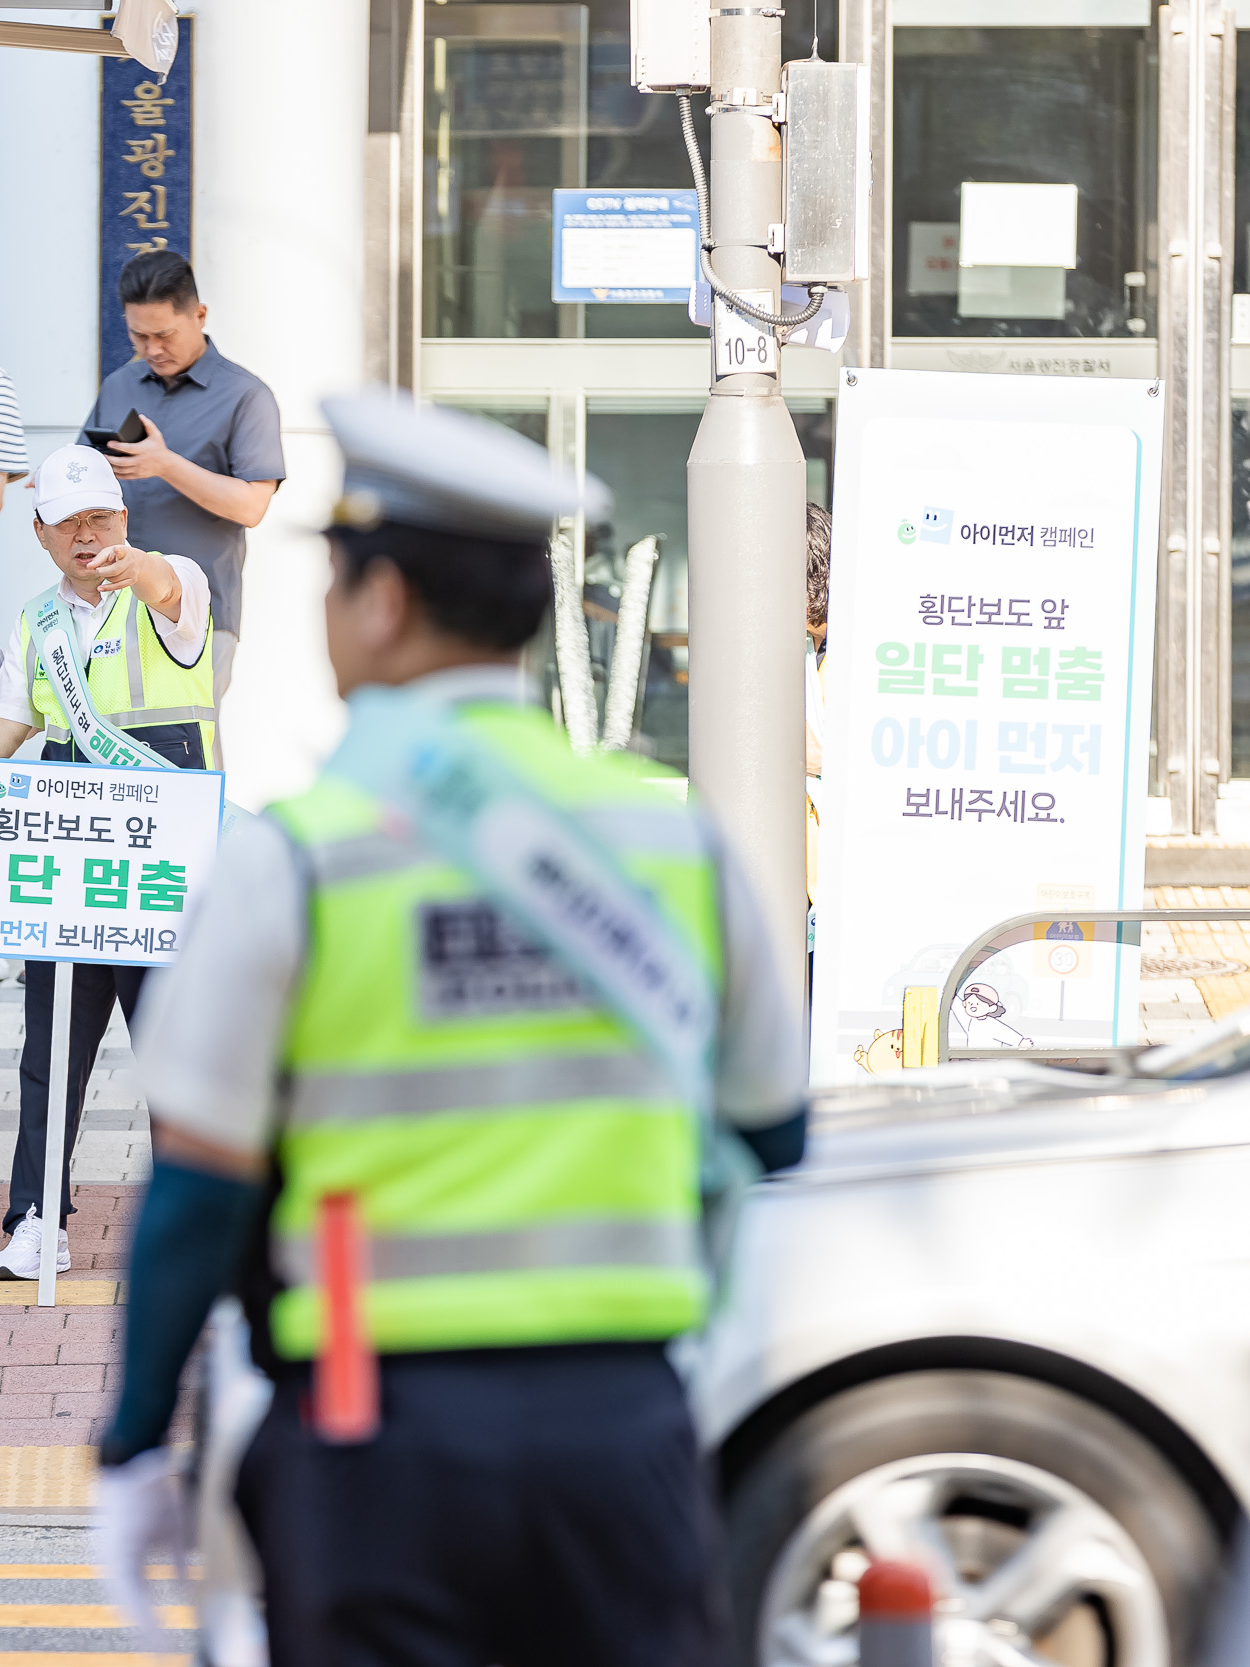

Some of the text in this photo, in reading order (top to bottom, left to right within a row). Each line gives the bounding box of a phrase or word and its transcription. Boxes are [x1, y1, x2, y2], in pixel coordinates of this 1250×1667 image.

[725, 336, 768, 365] 10-8
[960, 523, 1094, 549] 아이먼저 캠페인
[37, 610, 60, 628] 아이먼저
[918, 593, 1070, 630] 횡단보도 앞
[875, 641, 1105, 701] 일단 멈춤
[51, 645, 82, 714] 횡단보도
[78, 711, 91, 734] 앞
[871, 717, 1102, 776] 아이 먼저
[36, 779, 159, 804] 아이먼저 캠페인
[902, 787, 1065, 824] 보내주세요.
[126, 816, 157, 849] 앞
[83, 858, 188, 913] 멈춤
[0, 920, 48, 948] 먼저
[1054, 952, 1074, 967] 30
